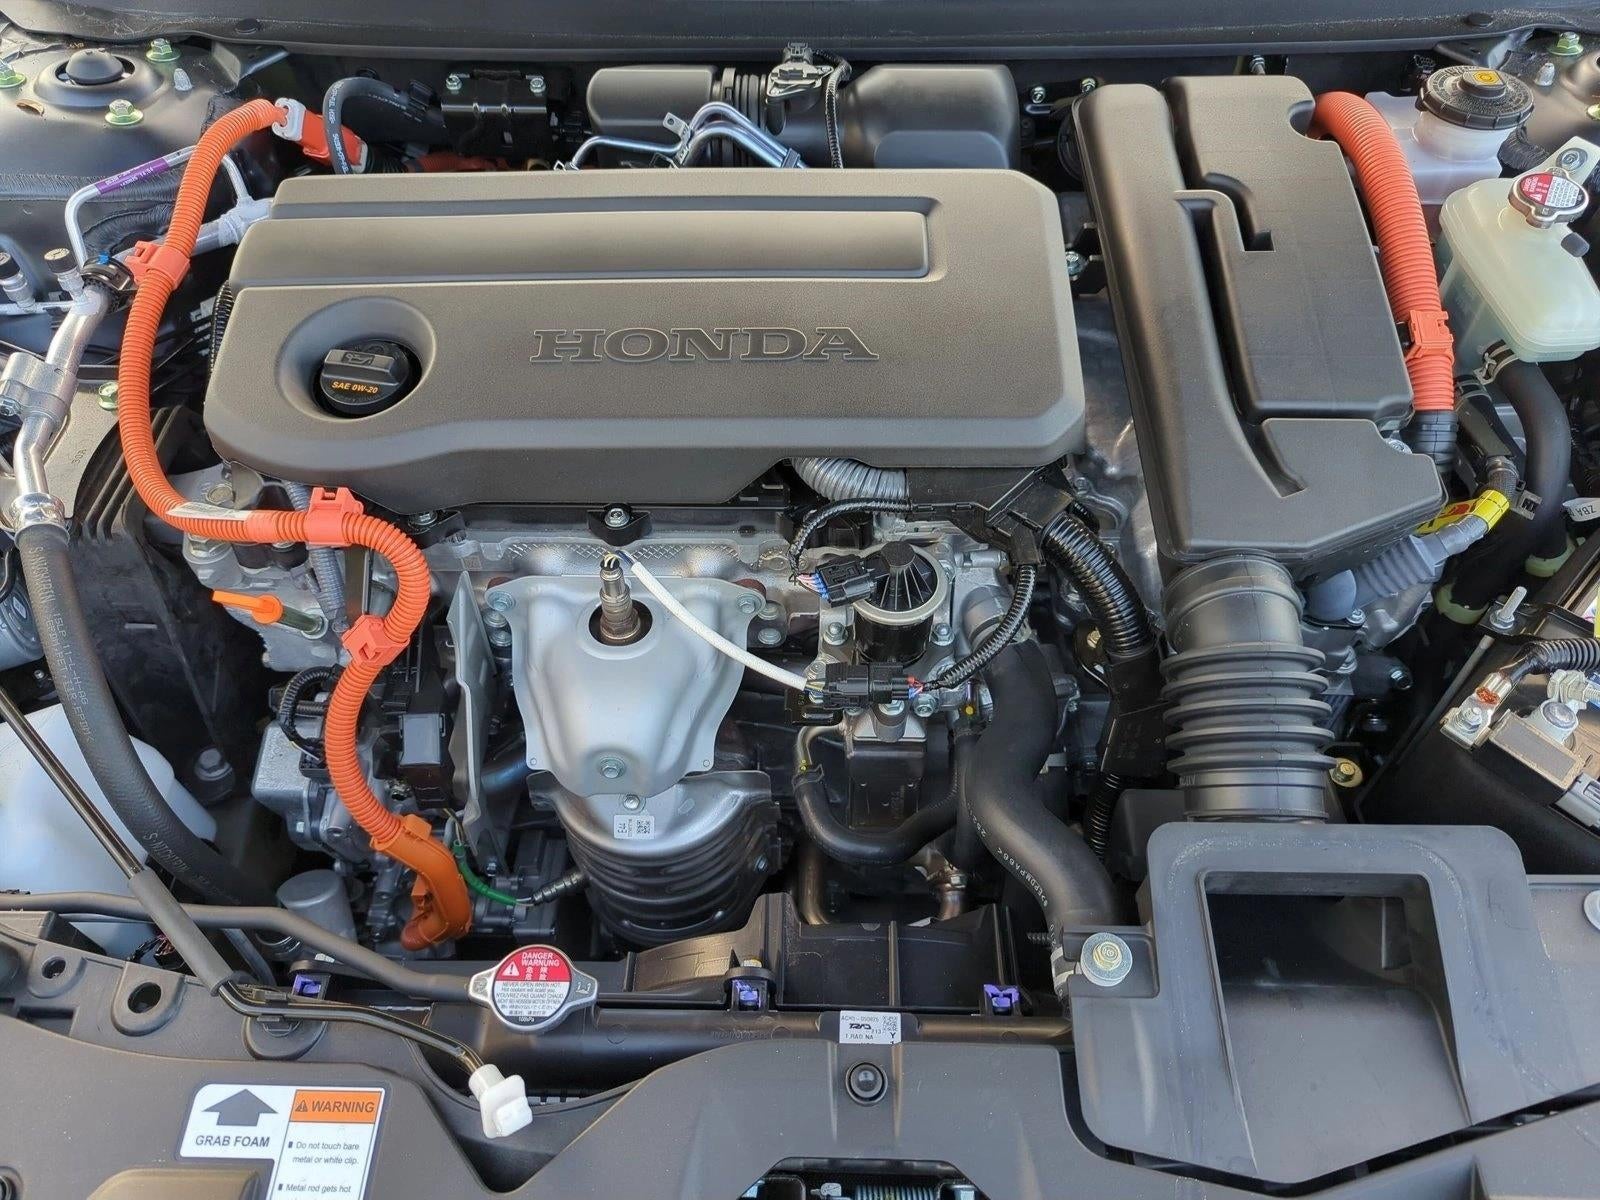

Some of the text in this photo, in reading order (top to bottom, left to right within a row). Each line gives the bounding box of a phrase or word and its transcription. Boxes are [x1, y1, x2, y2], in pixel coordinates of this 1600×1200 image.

[530, 327, 879, 362] HONDA
[331, 381, 379, 394] SAE 0W-20
[311, 1101, 375, 1113] WARNING
[196, 1135, 270, 1147] GRAB FOAM
[296, 1141, 306, 1149] Do
[322, 1142, 341, 1150] touch
[343, 1142, 359, 1150] bare
[286, 1184, 306, 1192] Metal
[308, 1184, 320, 1192] rod
[321, 1185, 337, 1194] gets
